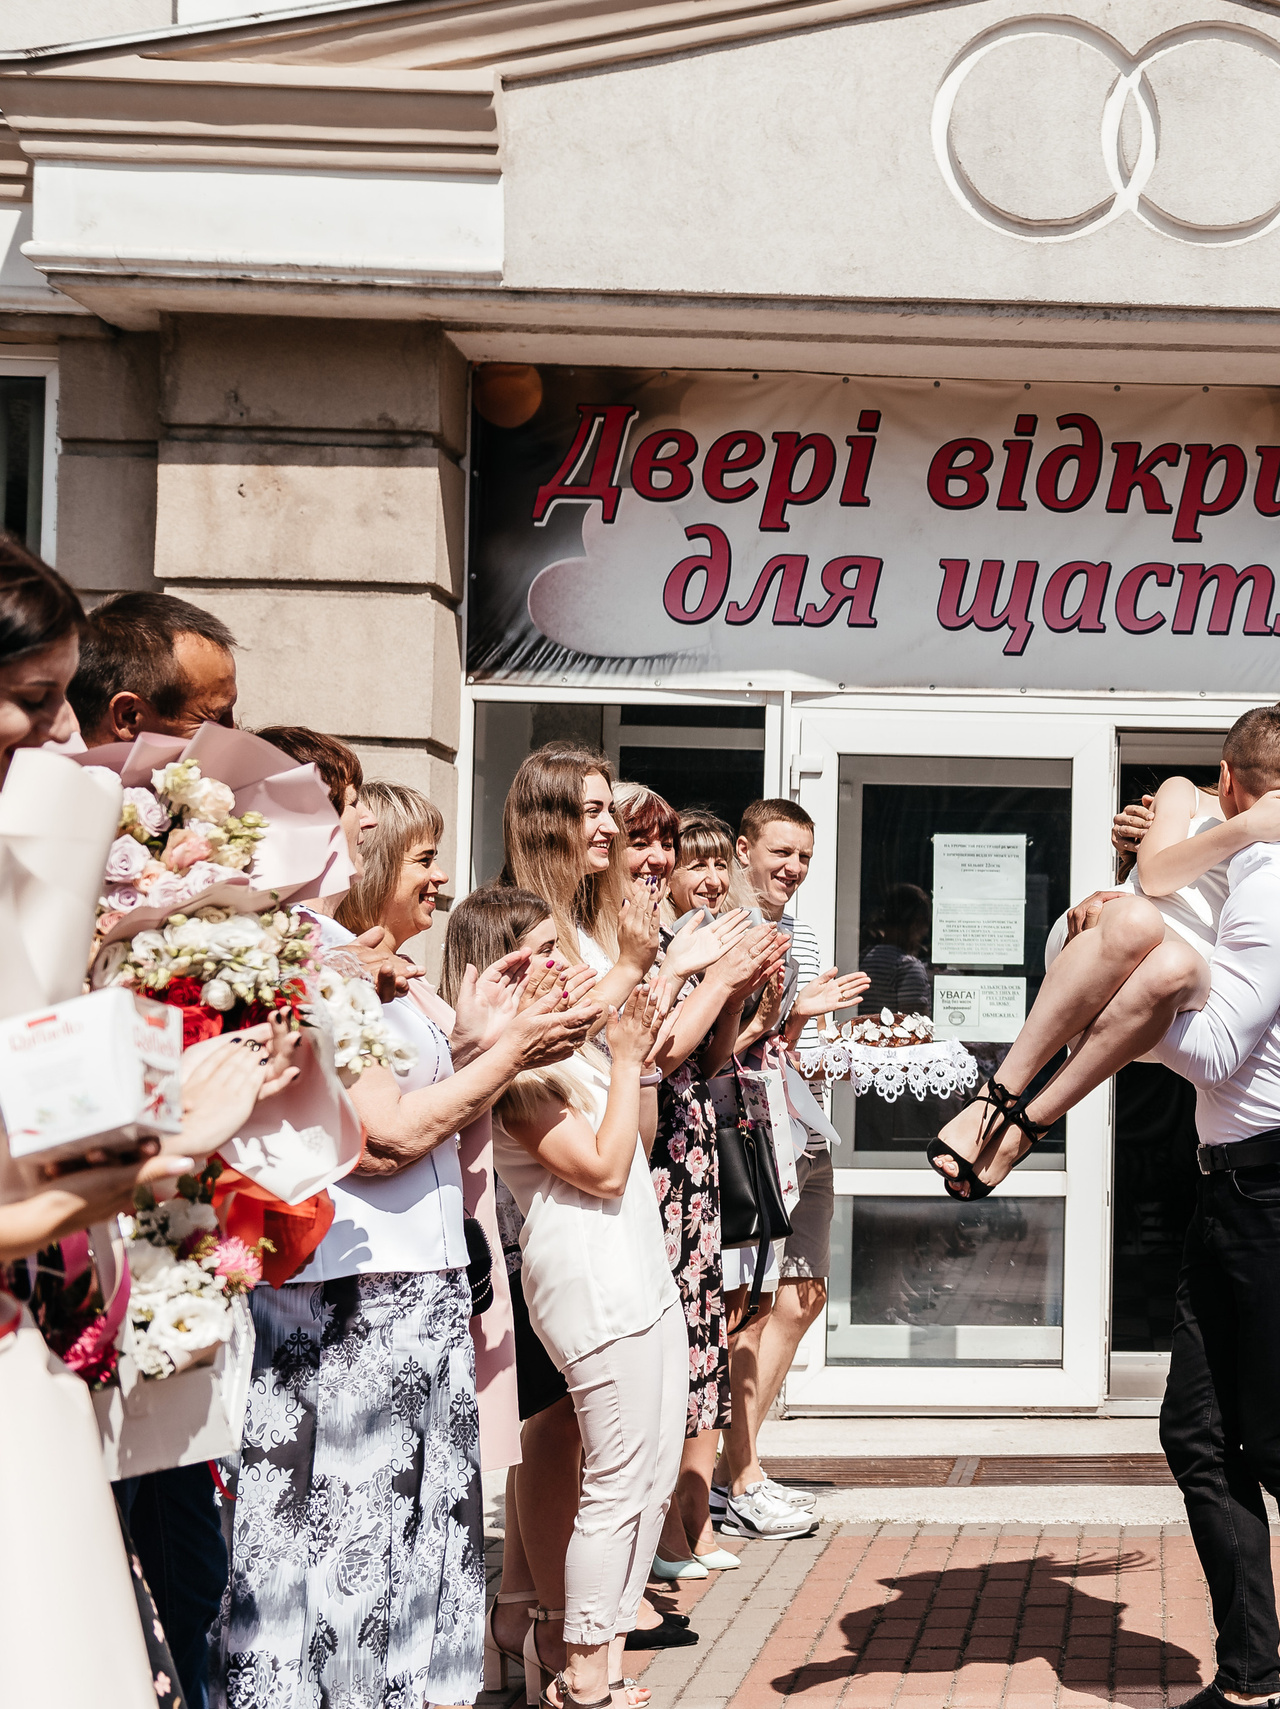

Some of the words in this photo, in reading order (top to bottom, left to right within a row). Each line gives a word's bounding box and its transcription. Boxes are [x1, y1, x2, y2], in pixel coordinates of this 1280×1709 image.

[531, 402, 882, 532] Двері
[661, 524, 884, 629] для
[939, 990, 976, 1000] УВАГА!
